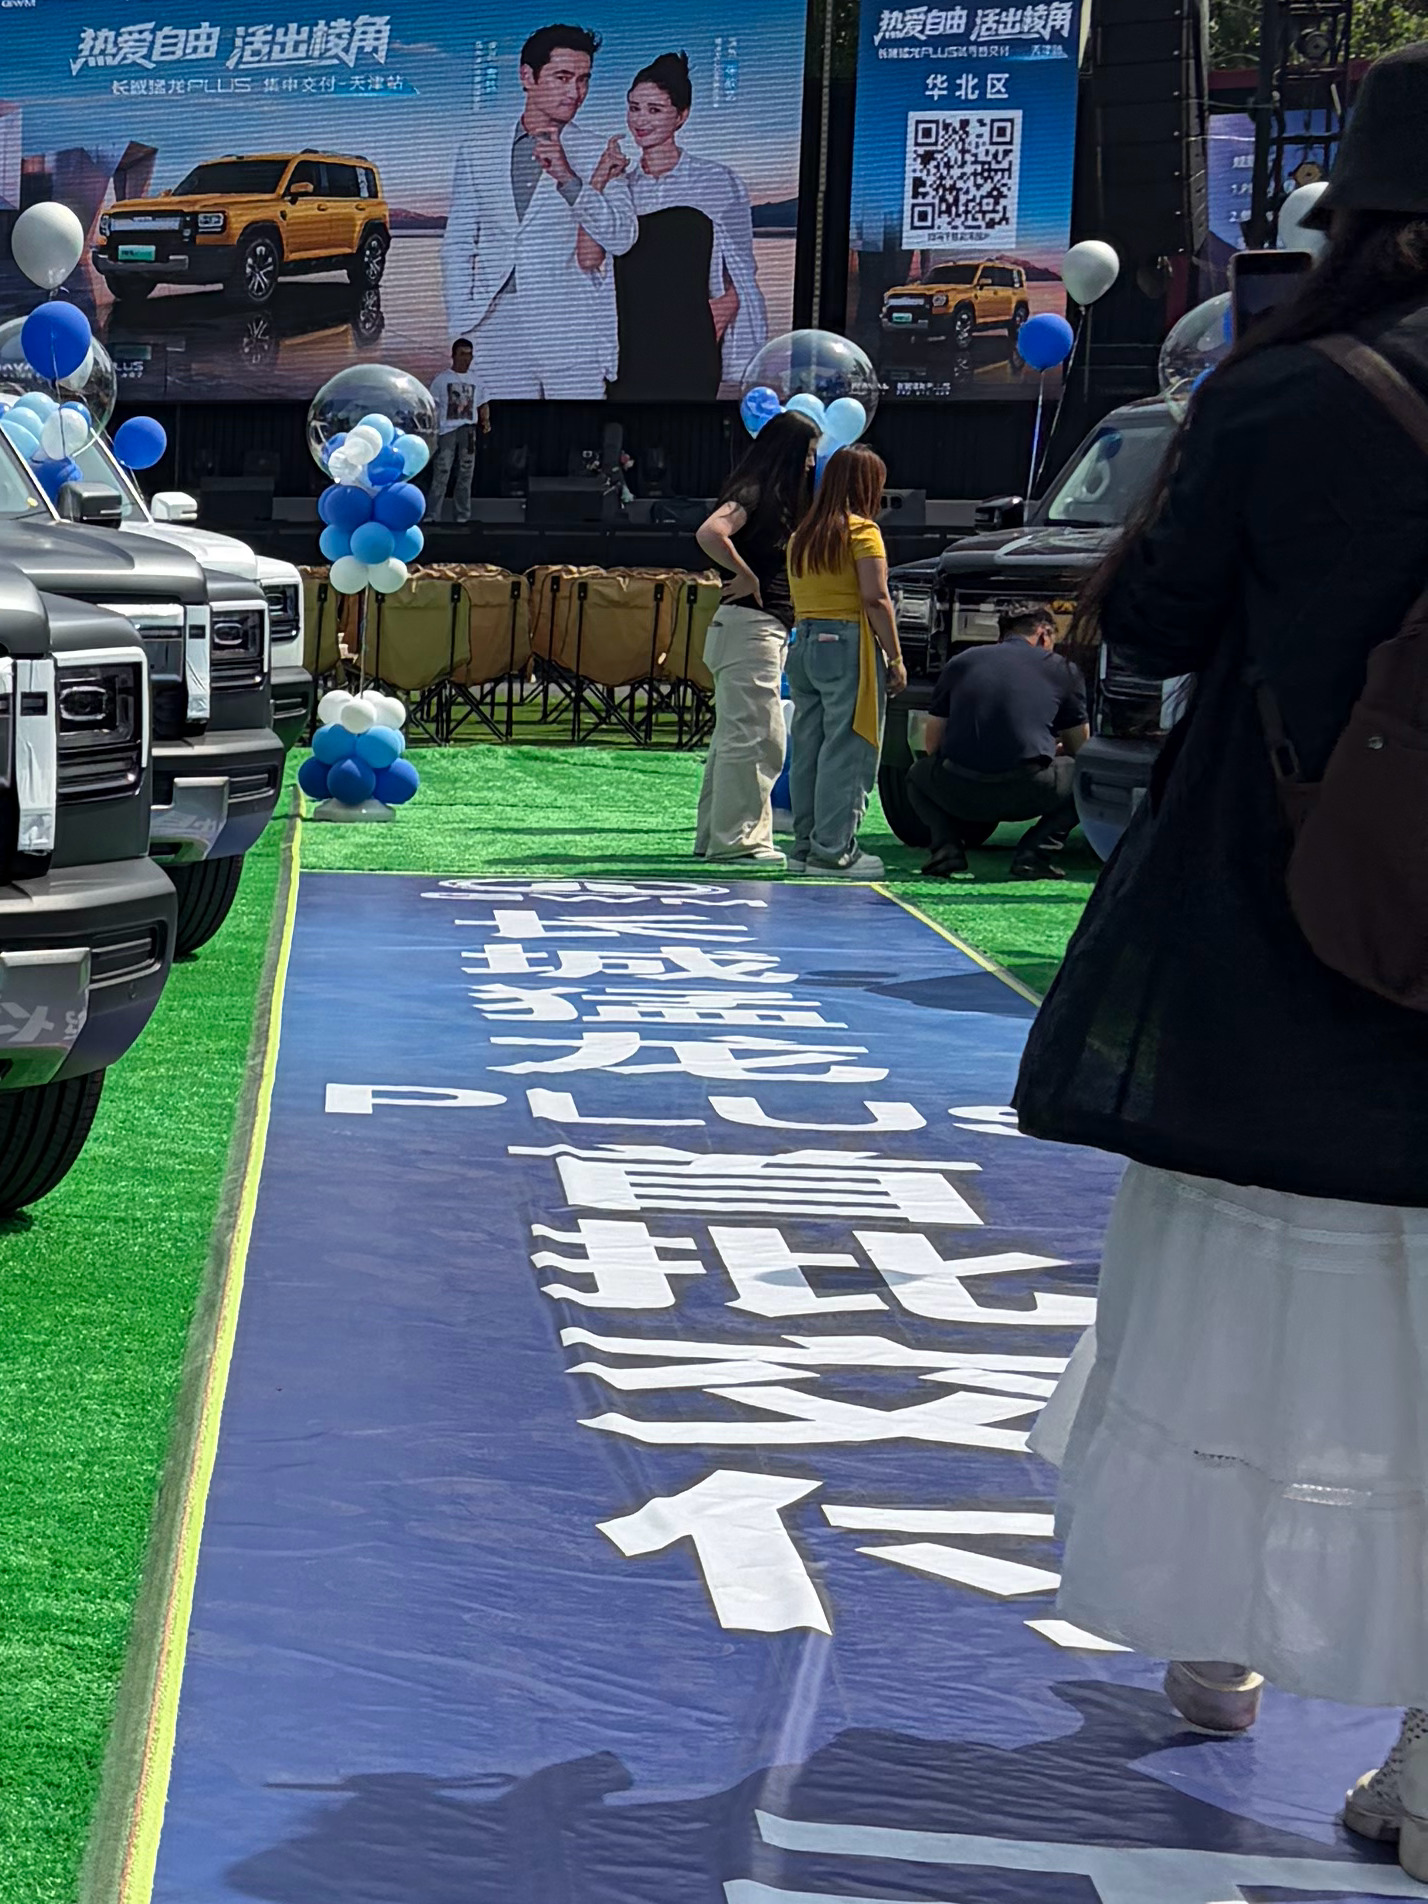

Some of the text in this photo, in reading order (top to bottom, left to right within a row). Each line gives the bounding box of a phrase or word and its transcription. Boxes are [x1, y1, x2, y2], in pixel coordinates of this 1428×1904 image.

[69, 14, 391, 76] 热爱自由 活出棱角
[874, 6, 968, 46] 热爱自由
[924, 73, 1010, 101] 华北区
